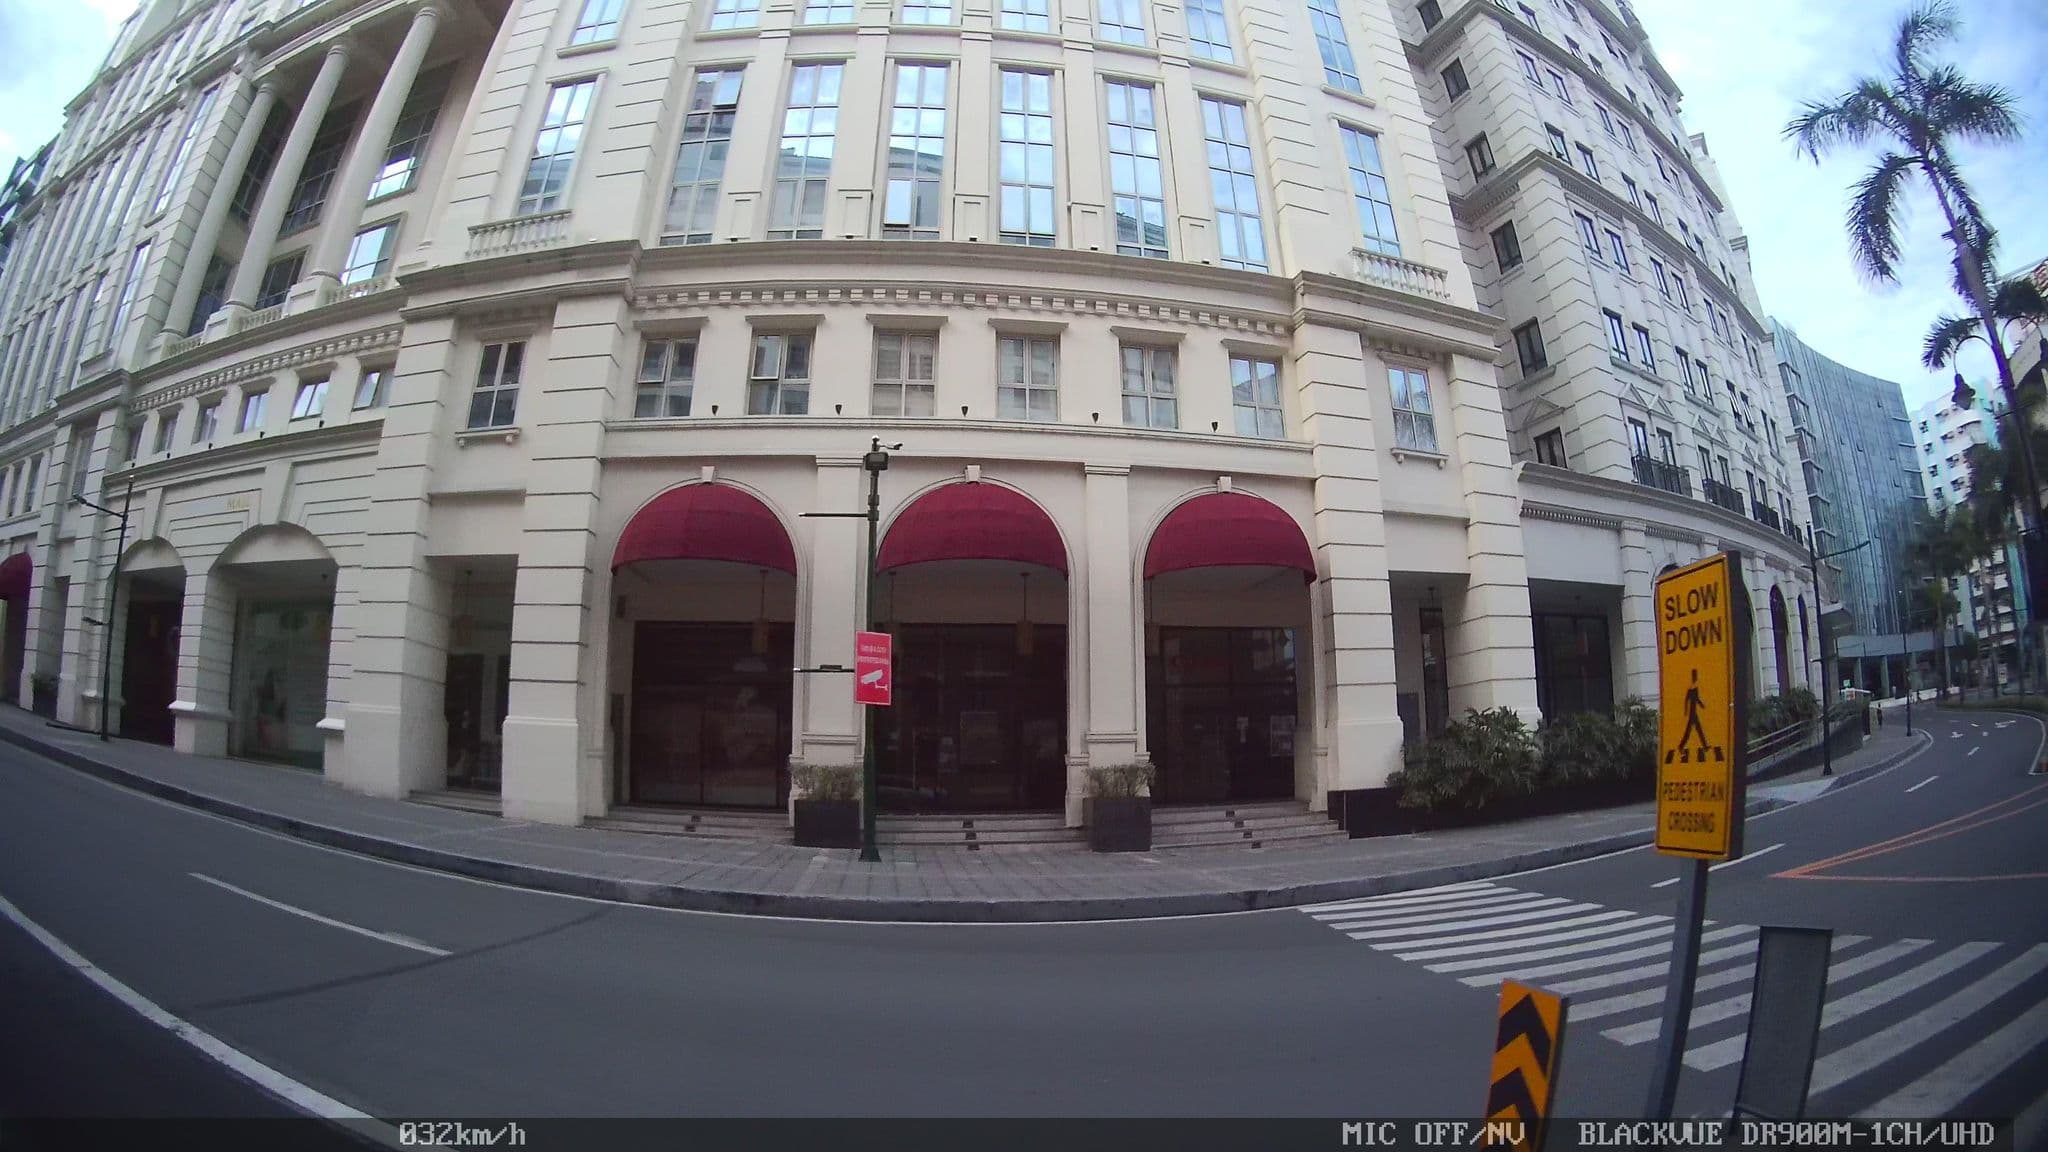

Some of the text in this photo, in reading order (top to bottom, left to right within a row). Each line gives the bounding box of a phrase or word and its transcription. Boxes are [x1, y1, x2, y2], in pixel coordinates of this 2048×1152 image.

[1665, 582, 1719, 621] SLOW
[1666, 616, 1722, 655] DOWN
[1664, 781, 1725, 801] PEDESTRIAN
[1668, 811, 1715, 833] CROSSING
